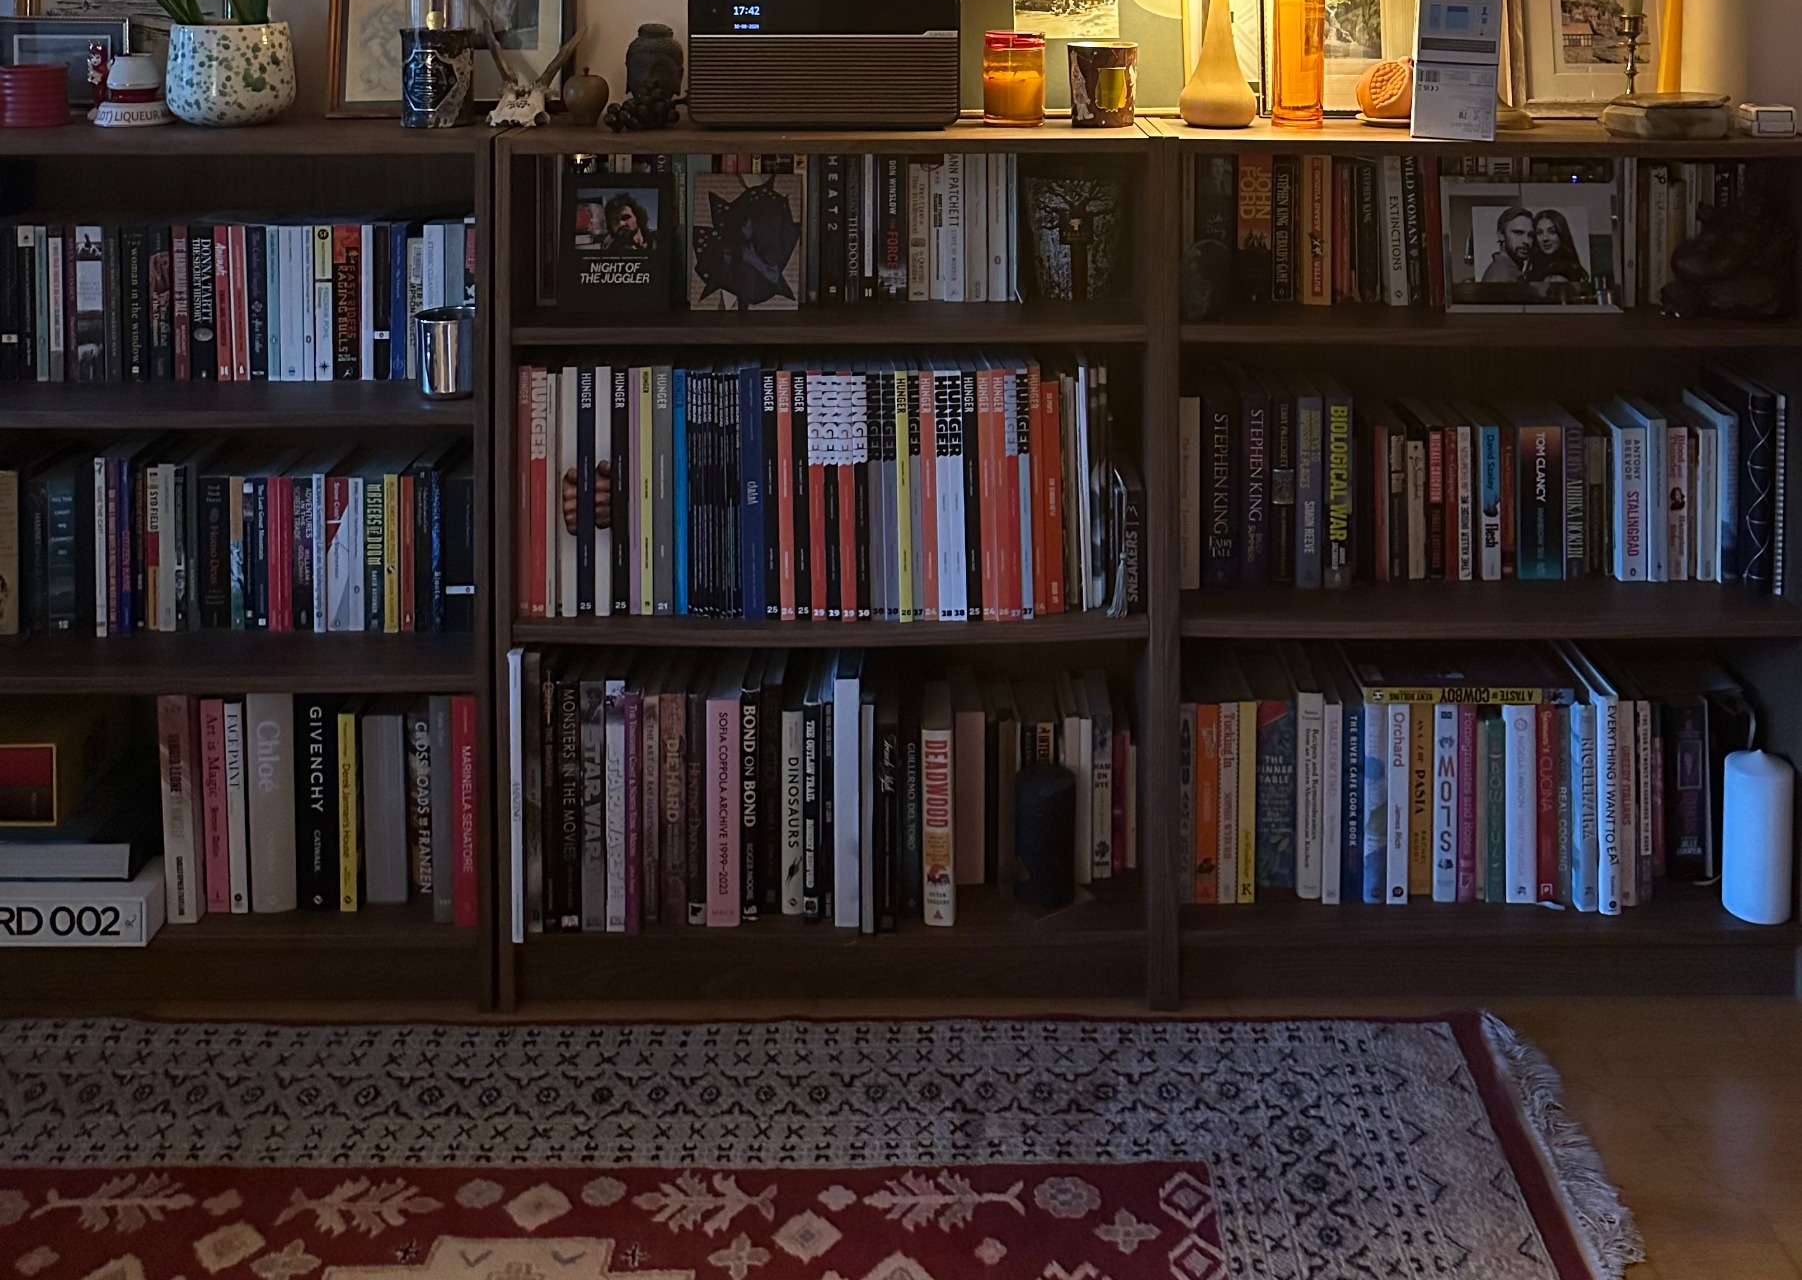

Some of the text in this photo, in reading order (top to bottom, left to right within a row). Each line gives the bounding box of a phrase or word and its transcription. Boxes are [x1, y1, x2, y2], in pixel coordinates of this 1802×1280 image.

[733, 5, 761, 16] 17:42
[828, 155, 838, 231] HEAT 2
[888, 160, 897, 215] DON WINSLOW
[949, 154, 959, 227] ANN PATCHETT
[1241, 166, 1256, 219] FORD
[1256, 166, 1271, 219] JOHN
[1363, 167, 1371, 223] STEPHEN KING
[1405, 156, 1419, 245] WILD WOMAN
[849, 216, 858, 278] THE DOOR
[1390, 195, 1402, 271] EXTINCTIONS
[193, 238, 202, 323] THE SECRET HISTORY
[201, 238, 213, 323] DONNA TARTT
[589, 273, 662, 285] THE JUGGLER
[599, 262, 655, 274] NIGHT OF
[130, 247, 142, 363] woman in the window
[337, 265, 348, 353] RAGING BULLS
[531, 371, 547, 461] HUNGER
[581, 372, 592, 408] HUNGER
[615, 372, 626, 408] HUNGER
[657, 373, 668, 409] HUNGER
[763, 376, 774, 412] HUNGER
[794, 376, 804, 412] HUNGER
[896, 378, 906, 414] HUNGER
[921, 378, 932, 413] HUNGER
[935, 375, 948, 458] HUNGER
[948, 375, 961, 457] HUNGER
[963, 376, 974, 413] HUNGER
[978, 376, 989, 413] HUNGER
[881, 374, 896, 462] HUNGER
[1213, 413, 1228, 534] STEPHEN KING
[1249, 409, 1264, 522] STEPHEN KING
[1329, 405, 1349, 541] BIOLOGICAL WAR
[1486, 434, 1496, 490] David Szalay
[1536, 431, 1546, 503] TOM CLANCY
[1624, 439, 1633, 480] BEEVOR
[1633, 439, 1641, 480] ANTONY
[150, 491, 158, 530] SYD FIELD
[258, 484, 266, 560] The Last Great Mountain
[300, 500, 306, 510] IN
[305, 487, 313, 539] ADVENTURES
[367, 484, 382, 565] MASTERS OF DOOM
[1305, 500, 1315, 554] SIMON REEVE
[1628, 490, 1640, 557] STALINGRAD
[122, 531, 131, 592] CITIZEN KANE
[1485, 523, 1498, 548] Flesh
[1126, 530, 1139, 602] SNEAKERS
[580, 602, 591, 610] 25
[615, 601, 626, 609] 25
[767, 606, 778, 614] 25
[798, 607, 809, 615] 25
[969, 608, 980, 616] 25
[1440, 688, 1490, 703] COWBOY
[1500, 691, 1526, 702] TASTE
[1526, 691, 1534, 702] A
[718, 712, 728, 742] SOFIA
[1222, 713, 1234, 768] Tucking In
[1311, 728, 1319, 759] Recipes
[1349, 715, 1358, 733] THE
[1349, 736, 1358, 764] RIVER
[1393, 712, 1405, 768] Orchard
[1606, 705, 1617, 781] EVERYTHING
[206, 713, 220, 797] Art is Magic
[227, 714, 240, 789] FACE PAINT
[257, 720, 280, 793] Chloé
[310, 706, 324, 813] GIVENCHY
[563, 689, 576, 861] MONSTERS IN THE MOVIES
[718, 745, 728, 791] COPPOLA
[743, 705, 756, 827] BOND ON BOND
[806, 720, 815, 802] THE OUTLAW TRAIL
[1097, 772, 1108, 780] ON
[1257, 766, 1294, 774] DINNER
[1265, 756, 1284, 764] THE
[1311, 762, 1319, 775] and
[585, 729, 601, 868] STAR WARS
[666, 740, 679, 823] DIE HARD
[789, 756, 800, 849] DINOSAURS
[906, 742, 916, 851] GUILLERMO DEL TORO
[924, 740, 949, 828] DEADWOOD
[1259, 775, 1290, 783] TABLE
[1349, 791, 1358, 818] COOK
[1462, 711, 1475, 855] Pomegranates and Roses
[343, 763, 352, 858] Derek Jarman's House
[416, 721, 432, 893] CROSSROADS FRANZEN
[462, 745, 473, 873] MARINELLA SENATORE
[718, 796, 728, 839] ARCHIVE
[1394, 805, 1402, 849] James Rich
[1559, 787, 1568, 872] REAL COOKING
[1606, 790, 1617, 823] WANT
[313, 829, 321, 872] CATWALK
[1349, 820, 1358, 847] BOOK
[1605, 826, 1615, 844] TO
[1606, 846, 1619, 866] EAT
